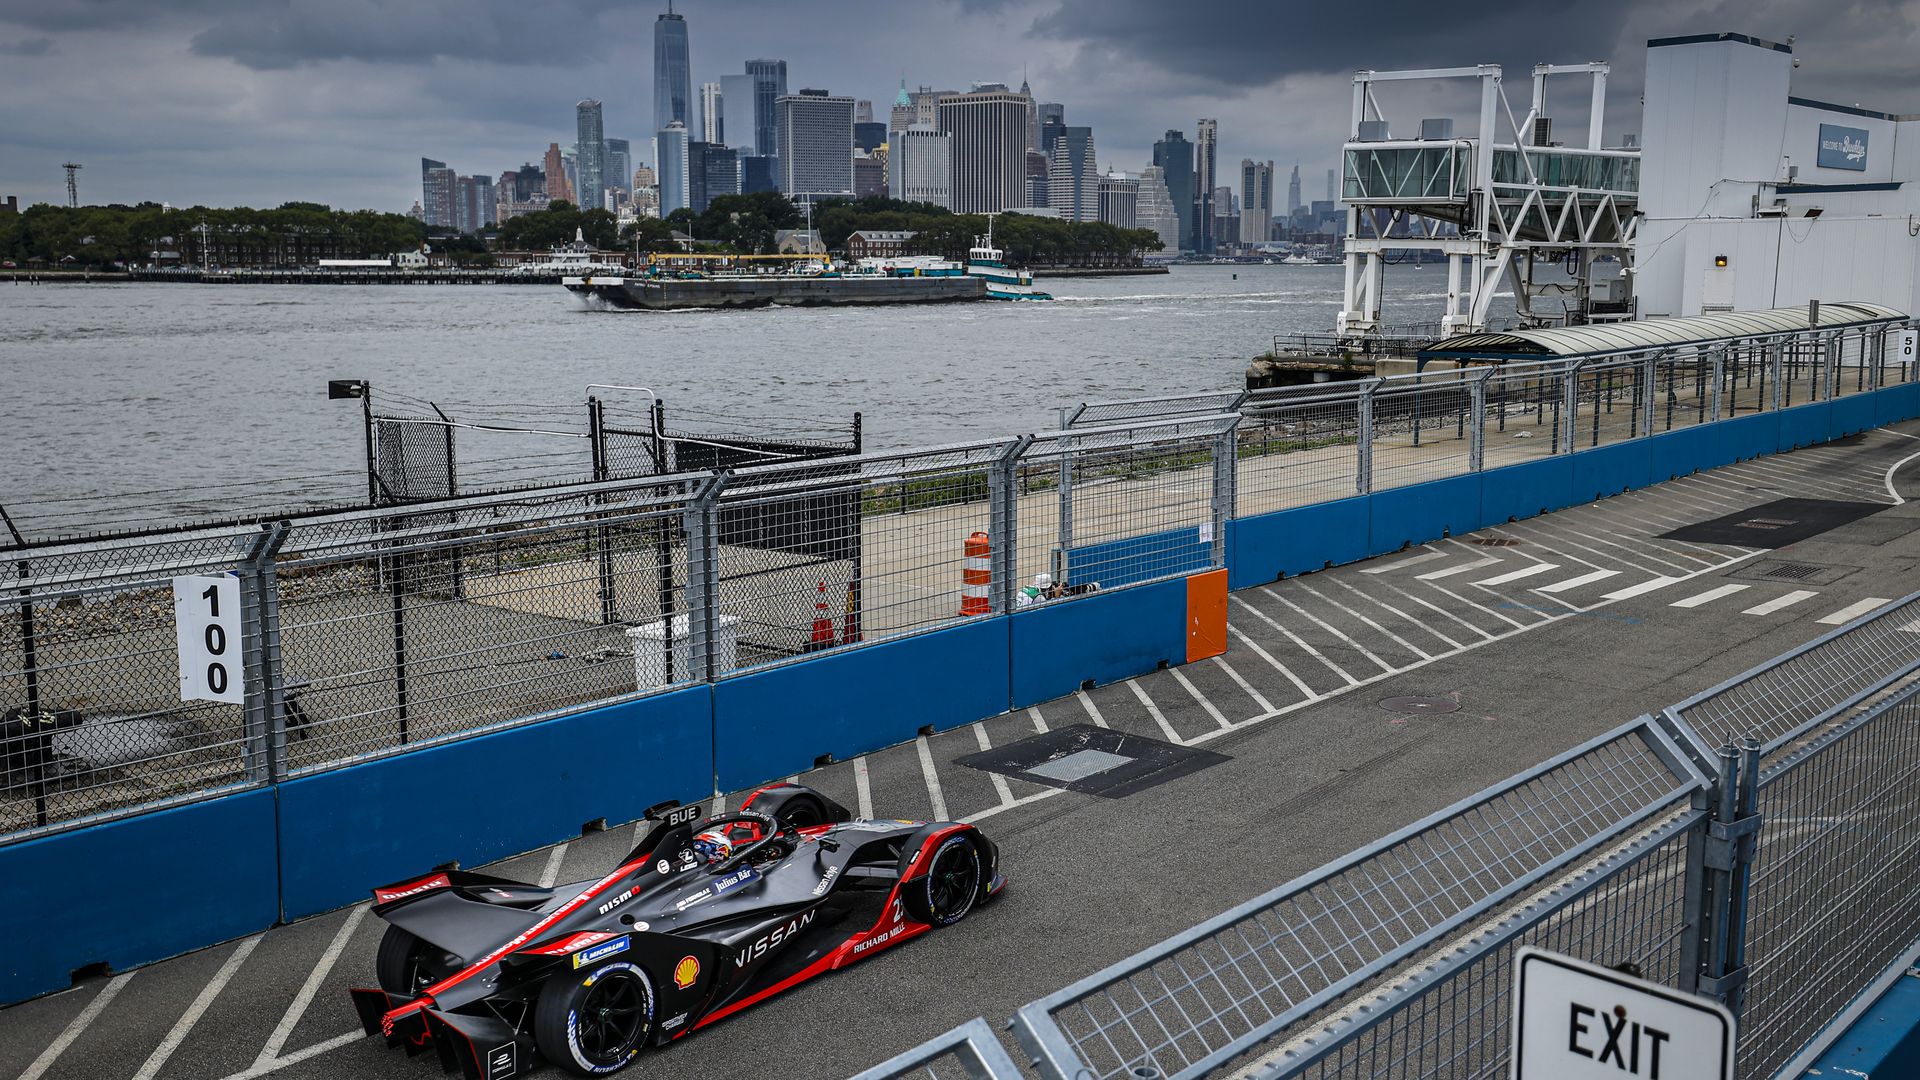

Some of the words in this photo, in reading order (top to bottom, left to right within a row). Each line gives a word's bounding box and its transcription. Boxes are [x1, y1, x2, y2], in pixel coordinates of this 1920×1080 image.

[1823, 140, 1838, 151] WELCOME
[1843, 136, 1865, 163] Brooklyn
[1904, 337, 1912, 355] 50
[202, 585, 228, 694] 100
[669, 807, 697, 826] BUE
[382, 880, 442, 900] nismo
[715, 875, 738, 893] Julius
[737, 868, 751, 882] Bär
[812, 878, 829, 896] Nissan
[823, 865, 838, 881] Ariya
[598, 885, 641, 915] nismo
[589, 941, 625, 959] MICHELIN
[735, 909, 815, 968] NISSAN
[853, 932, 888, 954] RICHARD
[889, 922, 906, 938] MILLE
[1569, 1002, 1670, 1080] EXIT
